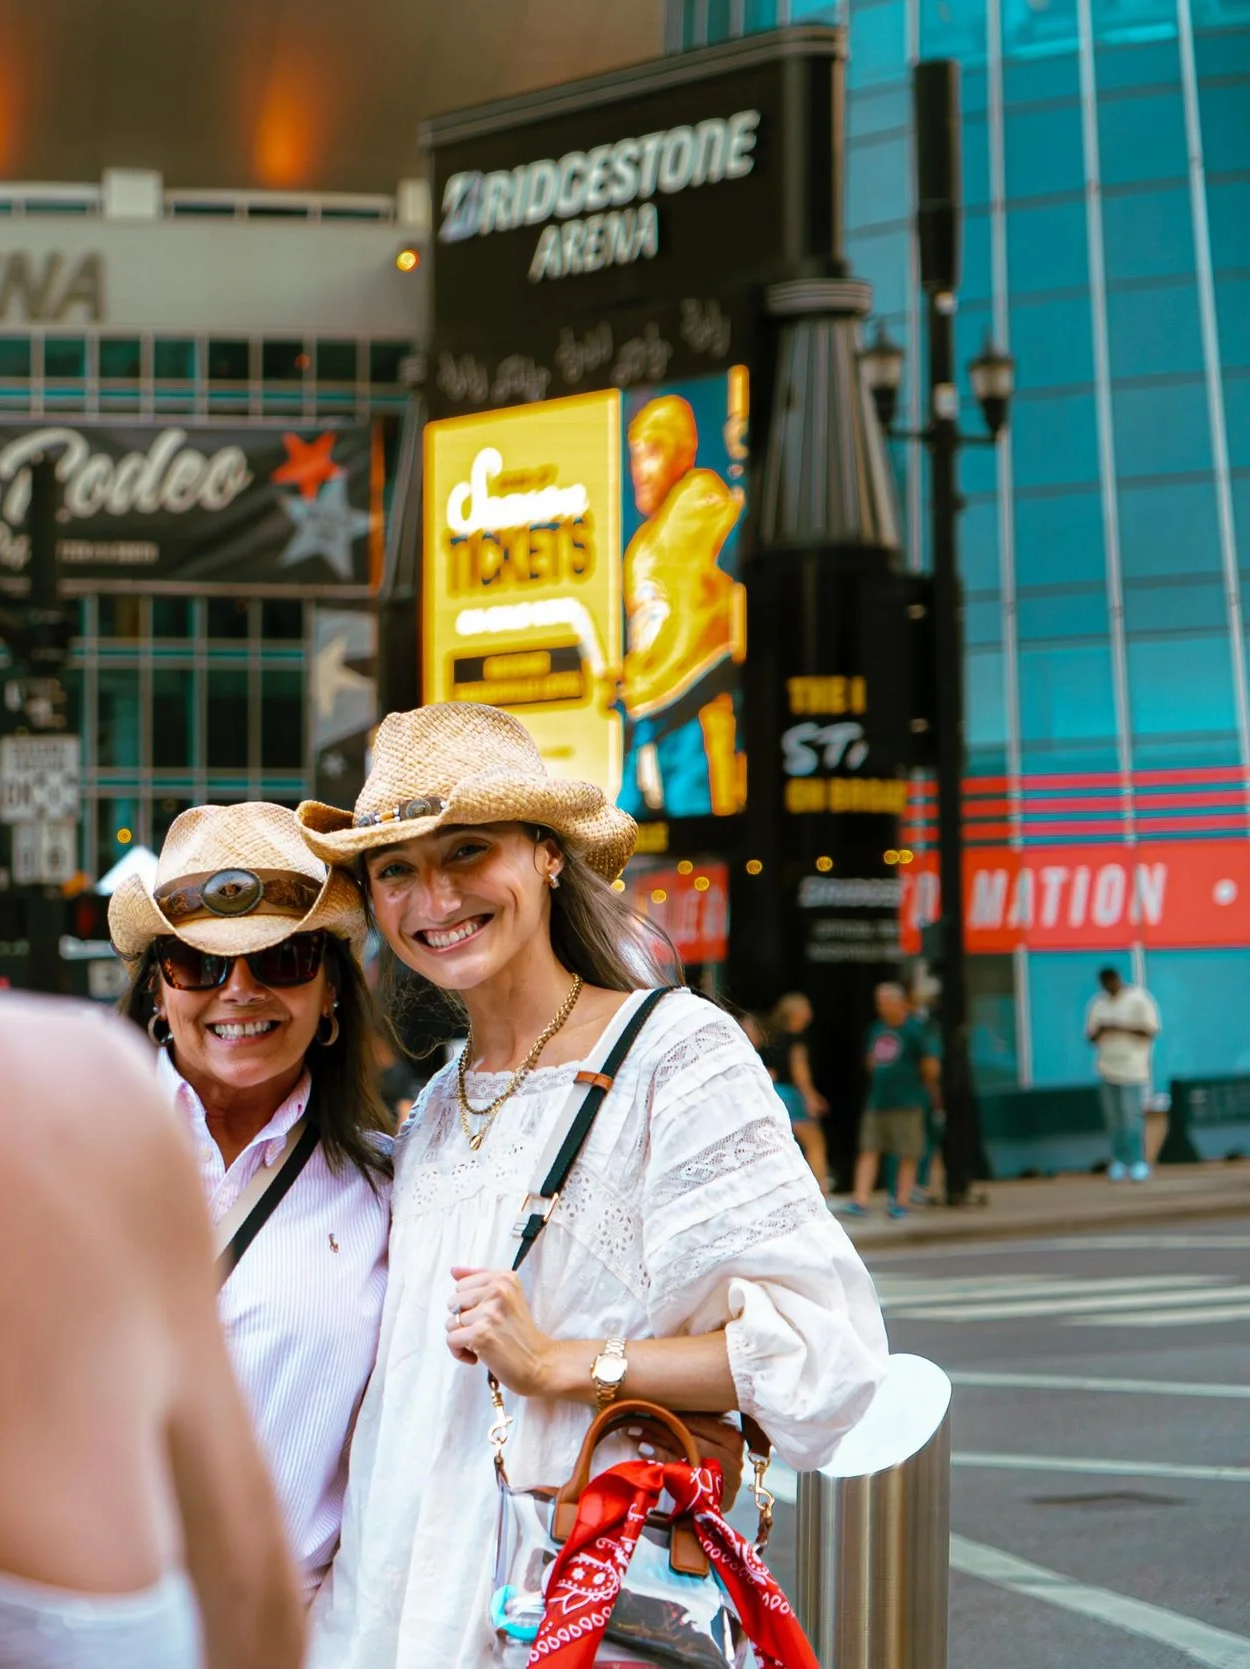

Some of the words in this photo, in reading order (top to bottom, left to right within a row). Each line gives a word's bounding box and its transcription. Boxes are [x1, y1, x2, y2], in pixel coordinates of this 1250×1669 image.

[438, 109, 761, 243] BRIDGESTONE
[528, 202, 659, 283] ARENA
[446, 512, 595, 598] TICKETS
